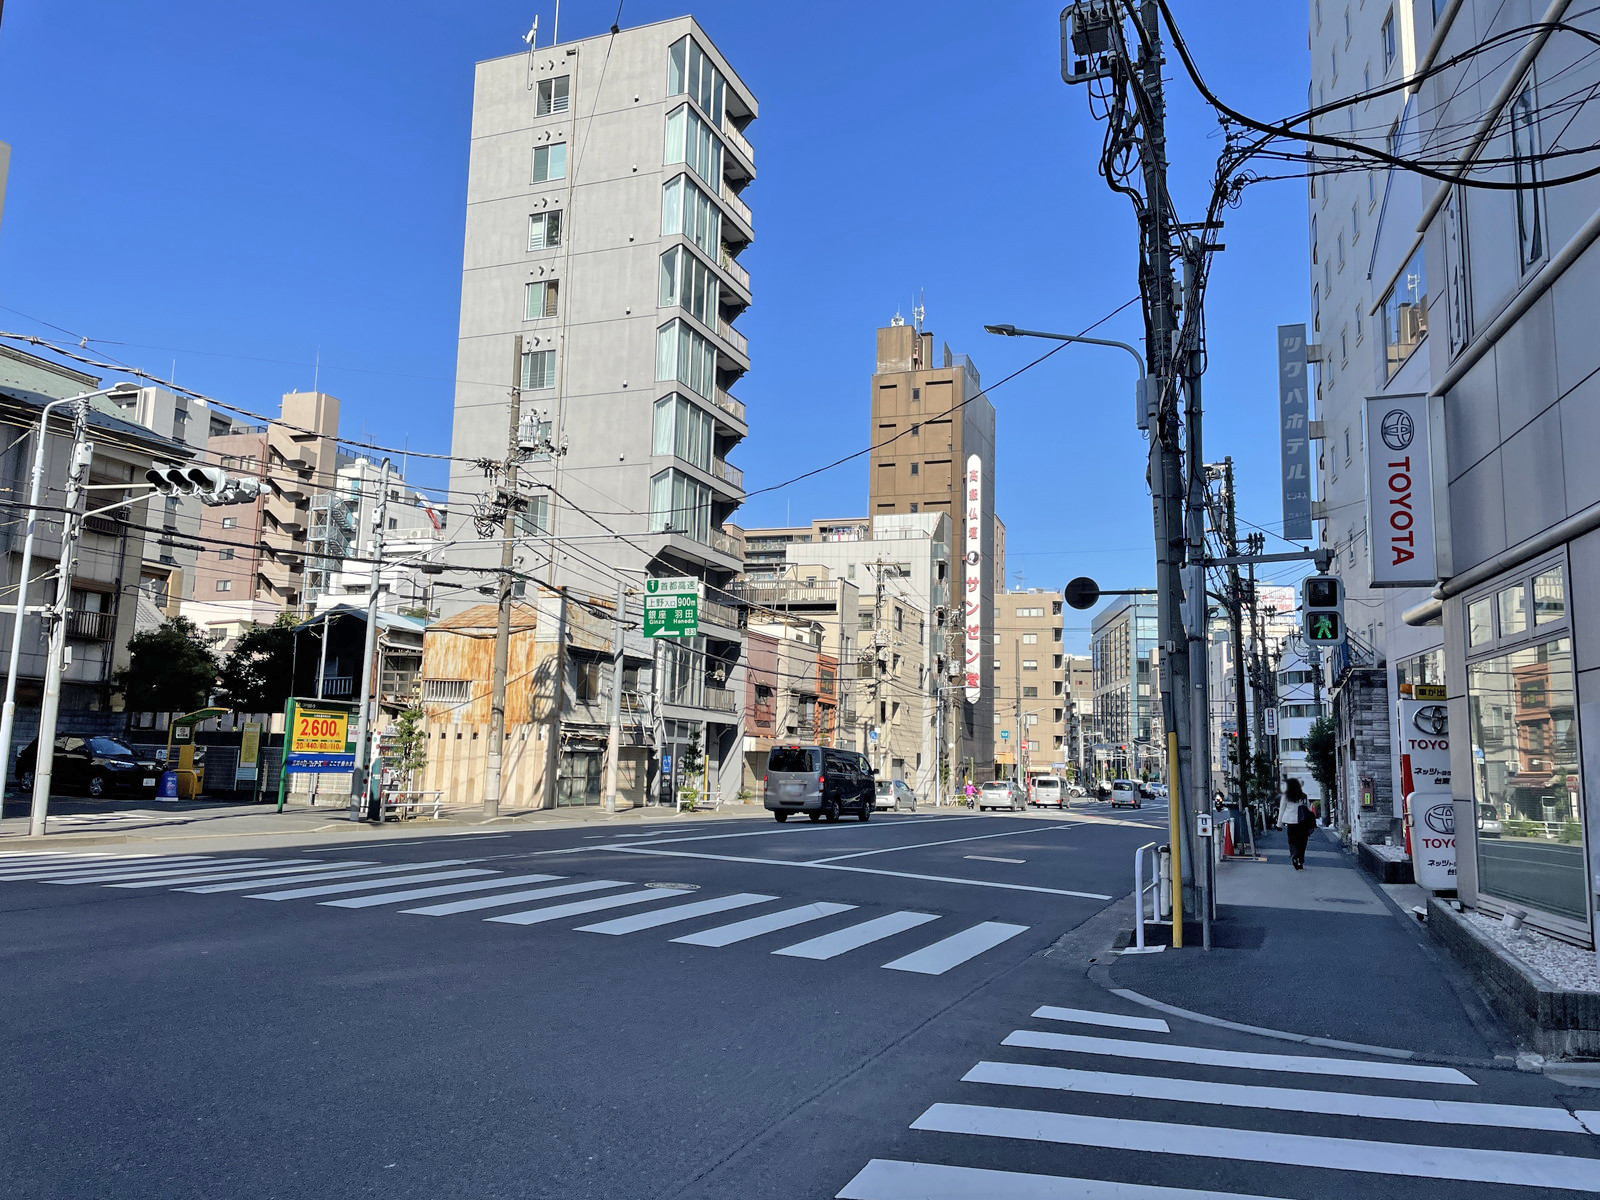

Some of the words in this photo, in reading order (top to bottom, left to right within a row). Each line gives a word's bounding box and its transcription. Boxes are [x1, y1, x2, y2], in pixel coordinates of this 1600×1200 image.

[1283, 336, 1306, 480] ツクバホテル
[1388, 456, 1415, 566] TOYOTA
[661, 581, 696, 590] 首都高速
[648, 598, 676, 607] 上野入口
[677, 597, 696, 606] 900m
[648, 610, 666, 619] 銀座
[674, 610, 693, 618] 羽田
[965, 577, 980, 688] サンゼン堂
[1428, 859, 1457, 867] ネッツト
